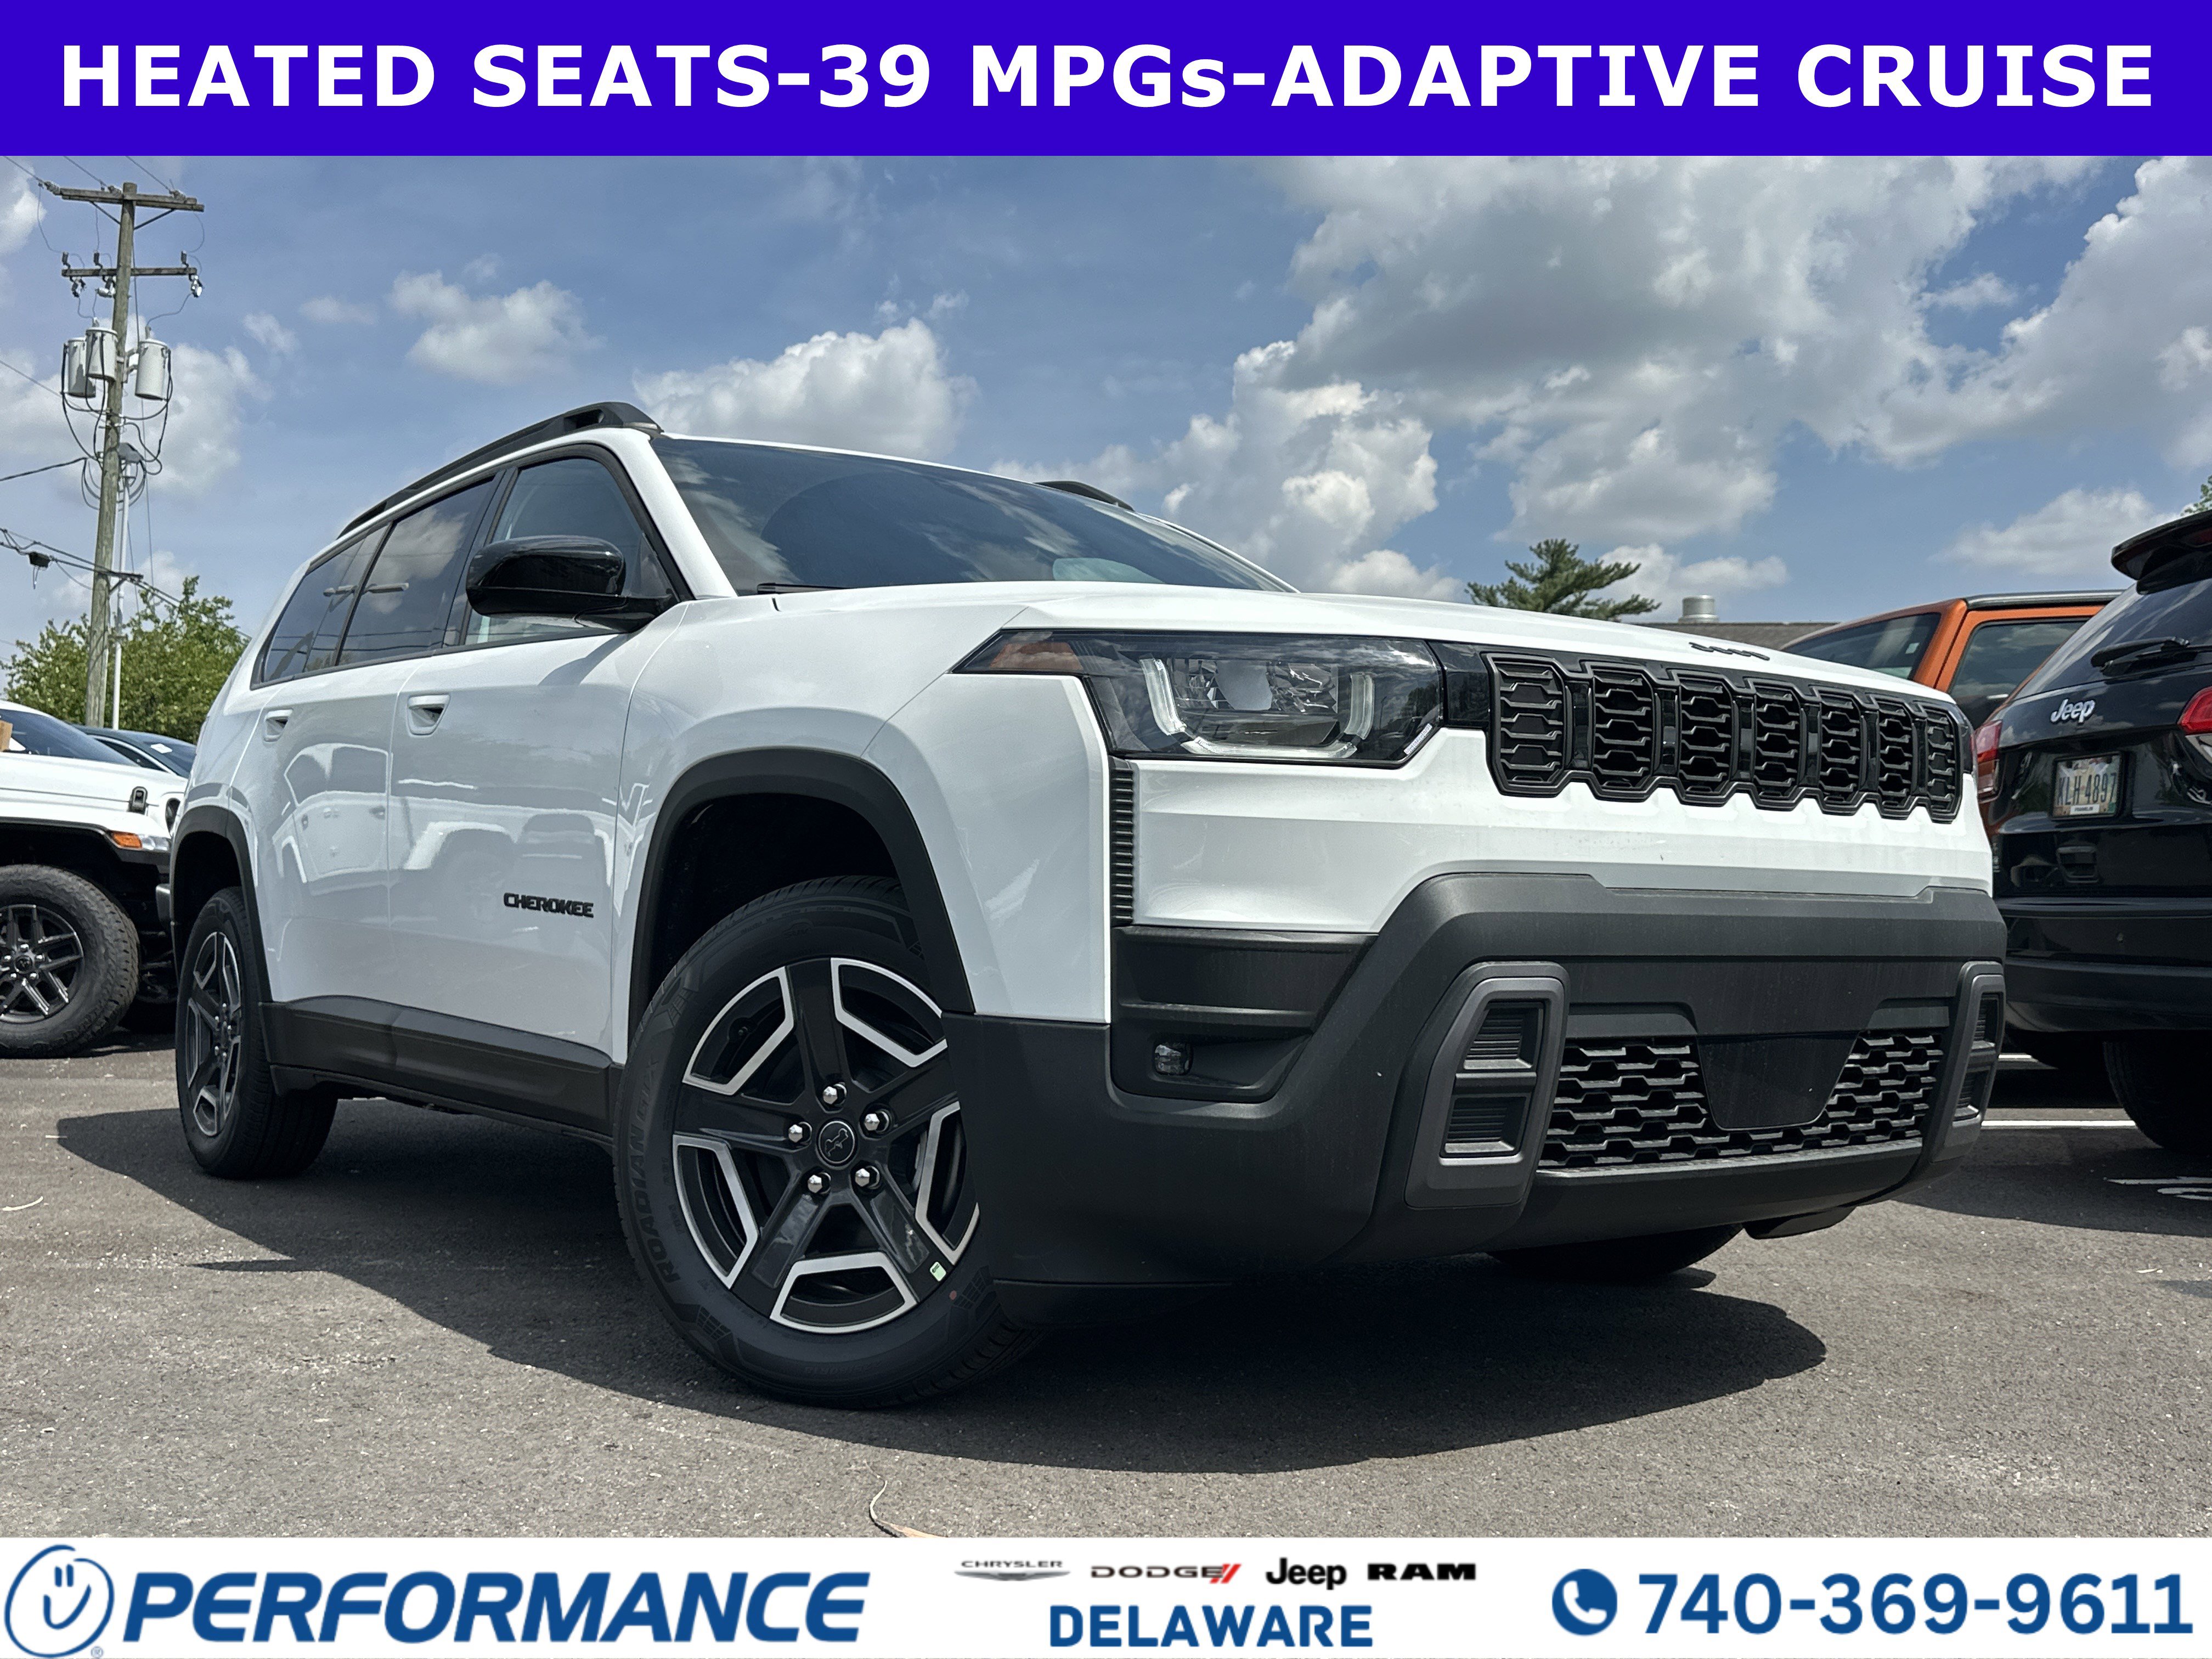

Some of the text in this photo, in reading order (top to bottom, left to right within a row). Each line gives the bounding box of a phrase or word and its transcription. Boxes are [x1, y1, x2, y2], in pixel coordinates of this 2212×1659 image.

[2050, 698, 2096, 723] Jeep
[2057, 773, 2117, 806] KLH 4897
[503, 892, 594, 918] CHEROKEE
[629, 1123, 681, 1284] ROADIAN
